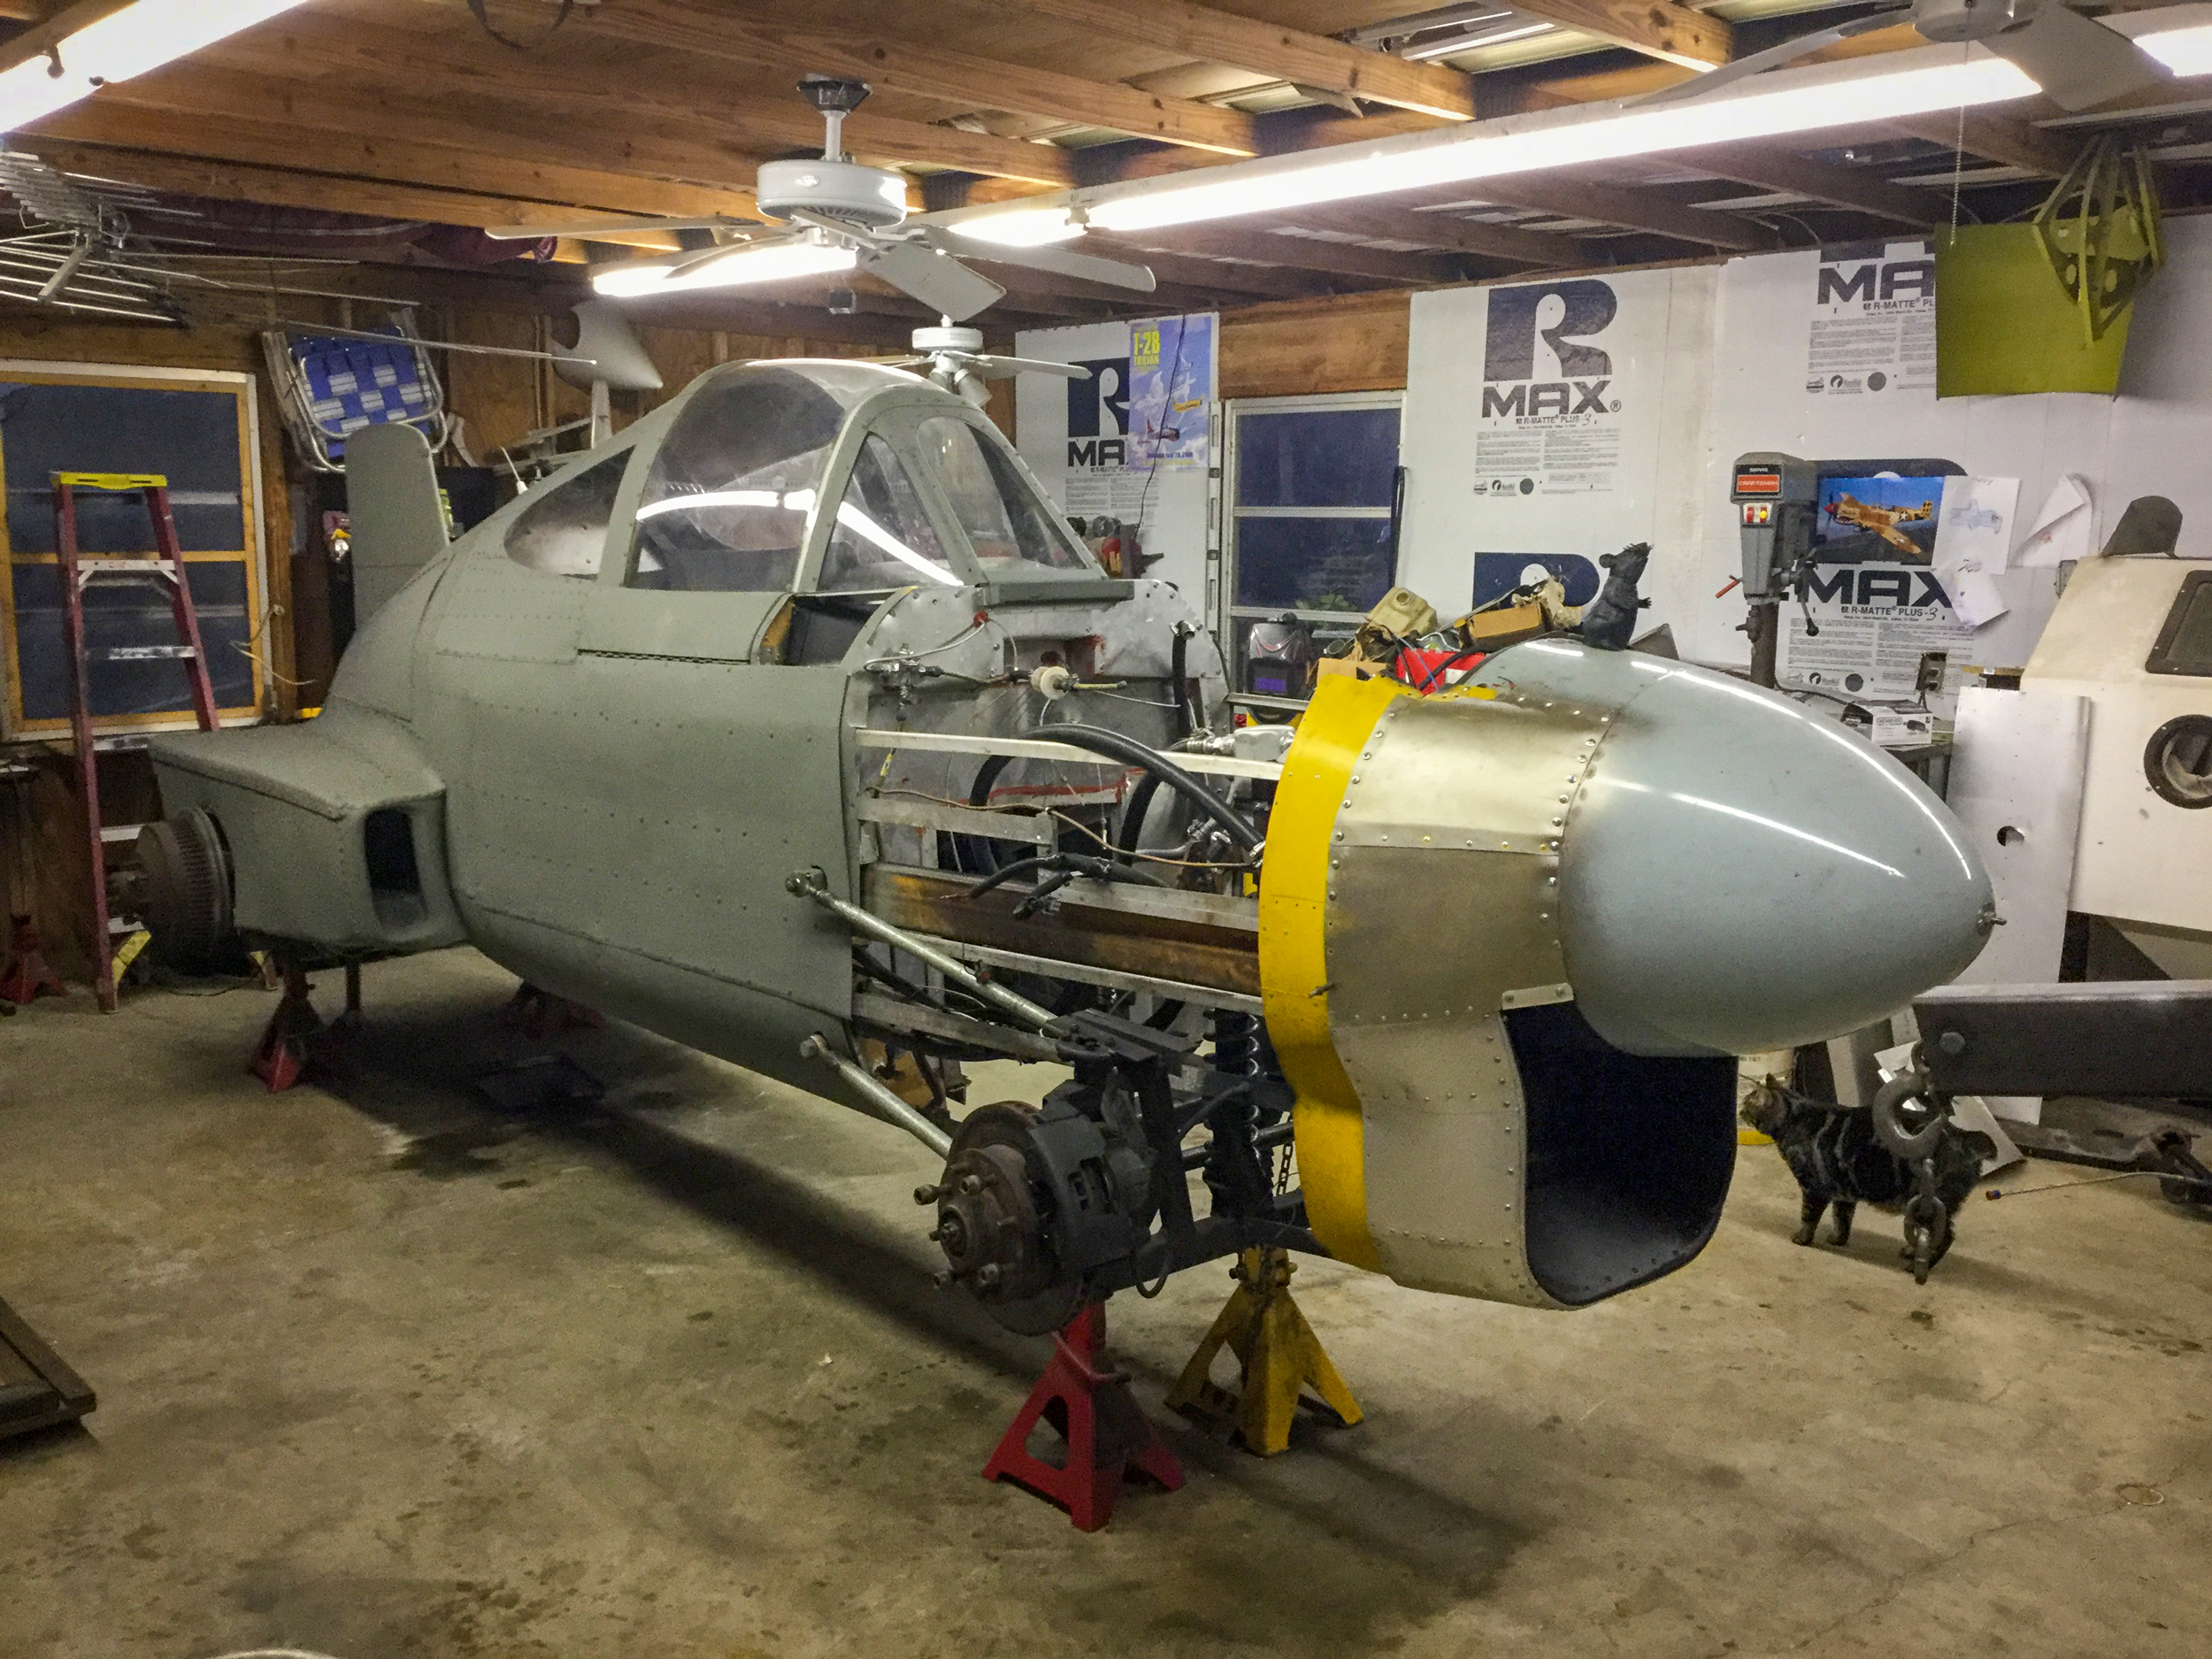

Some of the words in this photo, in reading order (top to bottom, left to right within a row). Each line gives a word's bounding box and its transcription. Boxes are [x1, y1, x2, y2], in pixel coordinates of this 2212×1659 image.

[1817, 260, 1935, 304] MA
[1873, 297, 1921, 310] R-MATTE
[1524, 414, 1560, 425] R-MATTE
[1067, 439, 1130, 467] MA
[1797, 569, 1954, 609] MAX
[1851, 605, 1897, 617] R-MATTE
